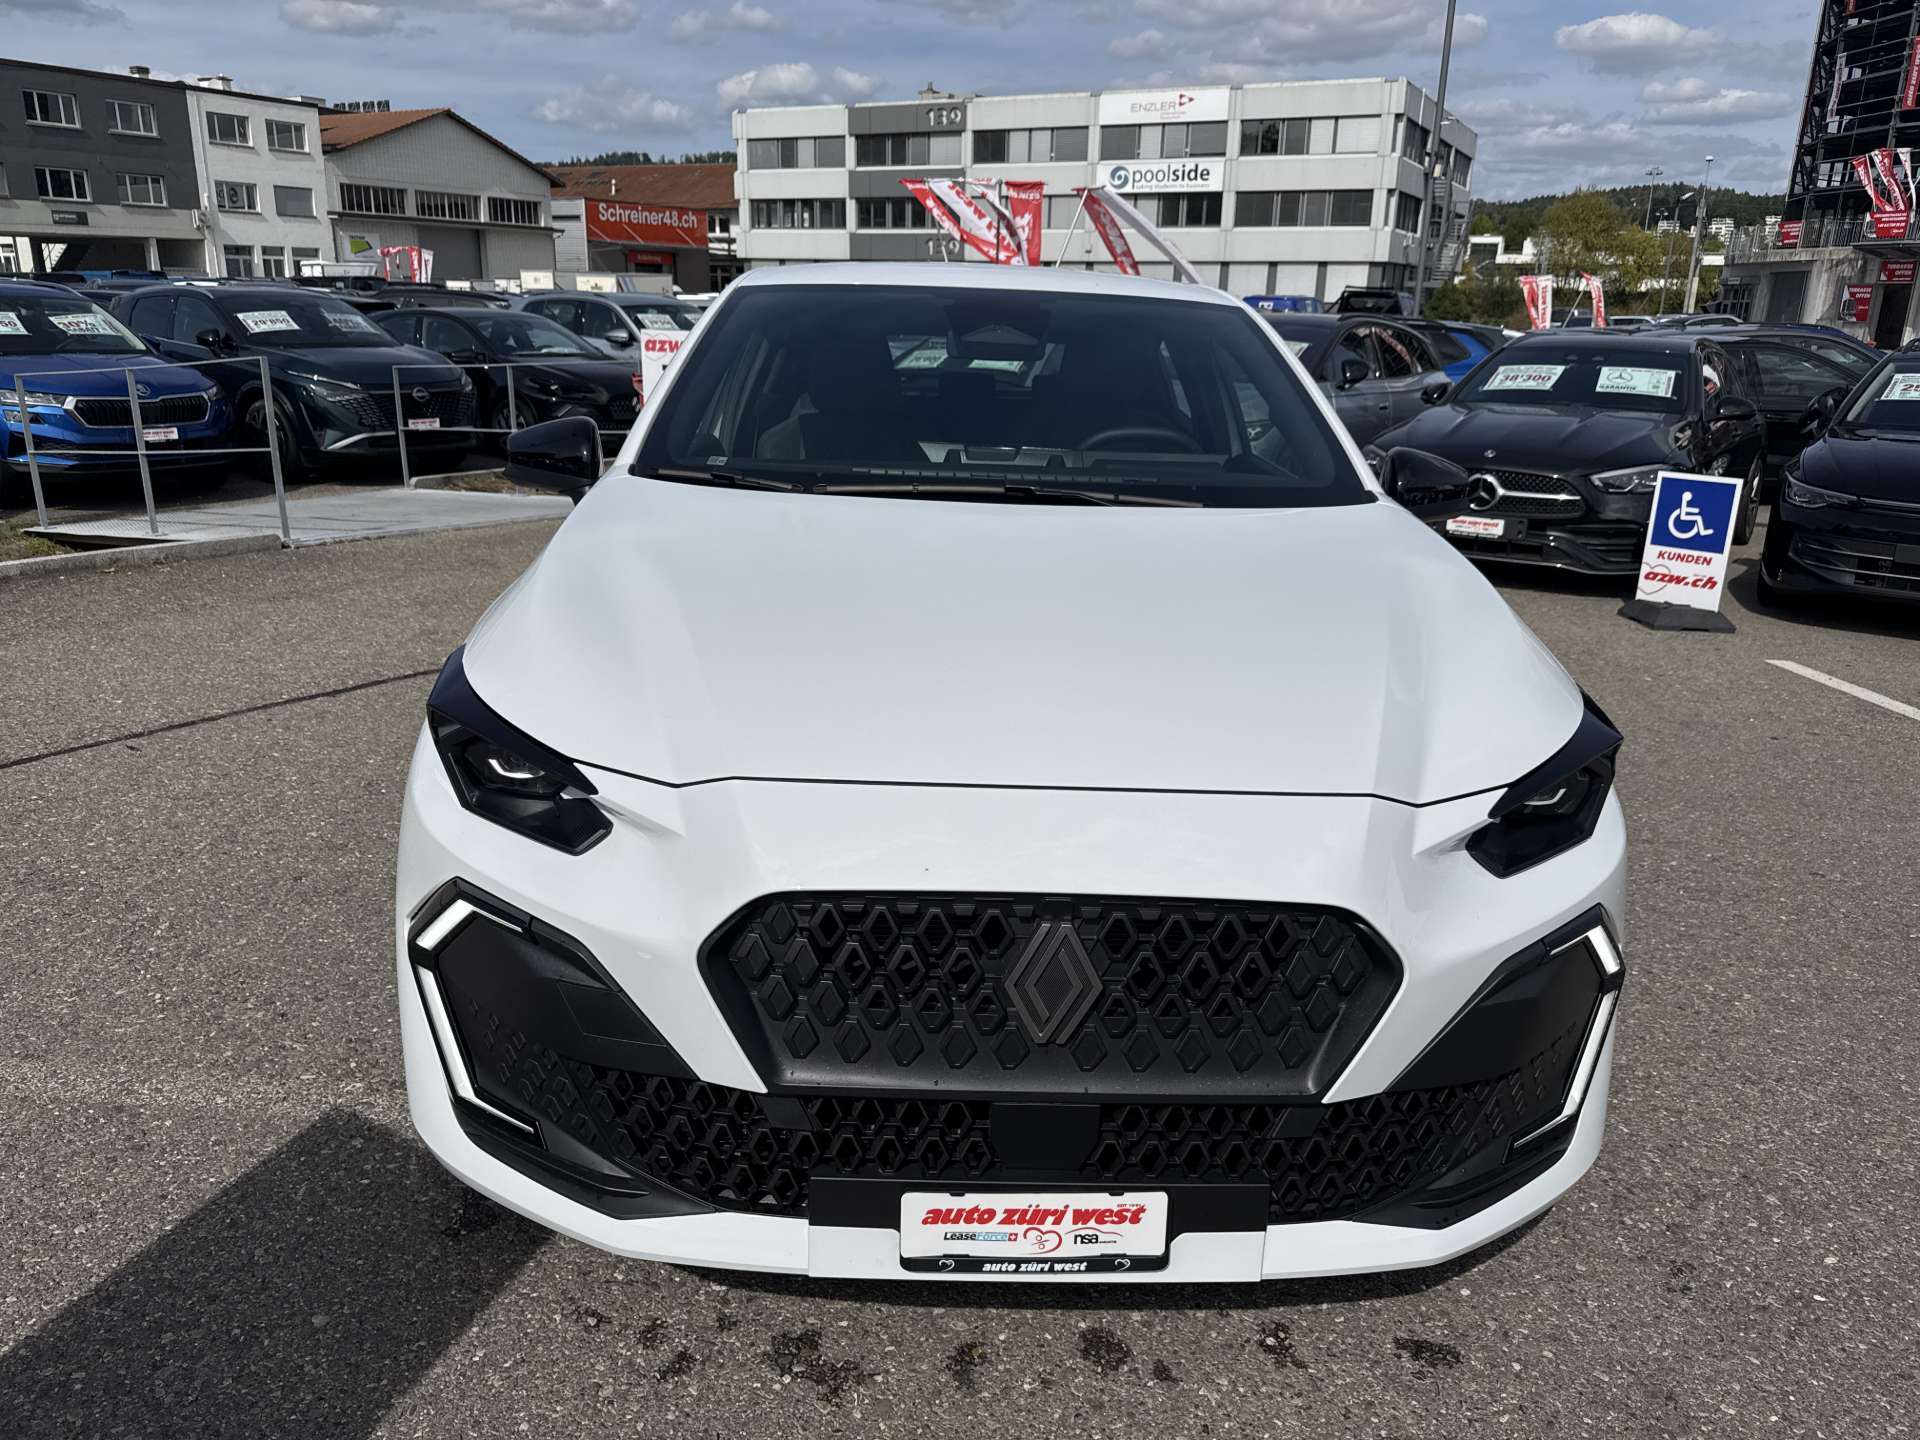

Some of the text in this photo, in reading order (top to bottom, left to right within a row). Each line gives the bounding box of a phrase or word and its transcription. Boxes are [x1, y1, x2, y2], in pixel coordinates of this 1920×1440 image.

[1130, 101, 1177, 112] ENZLER
[927, 107, 961, 126] 139
[1132, 163, 1211, 189] poolside
[598, 202, 698, 229] Schreiner48.ch
[1500, 374, 1552, 383] 38'300
[1656, 550, 1713, 566] KUNDEN
[1644, 571, 1718, 590] azw.ch
[921, 1203, 1147, 1225] auto züri west
[943, 1231, 1008, 1241] LeaseForce
[1073, 1233, 1099, 1244] nsa
[982, 1261, 1088, 1272] auto züri west
